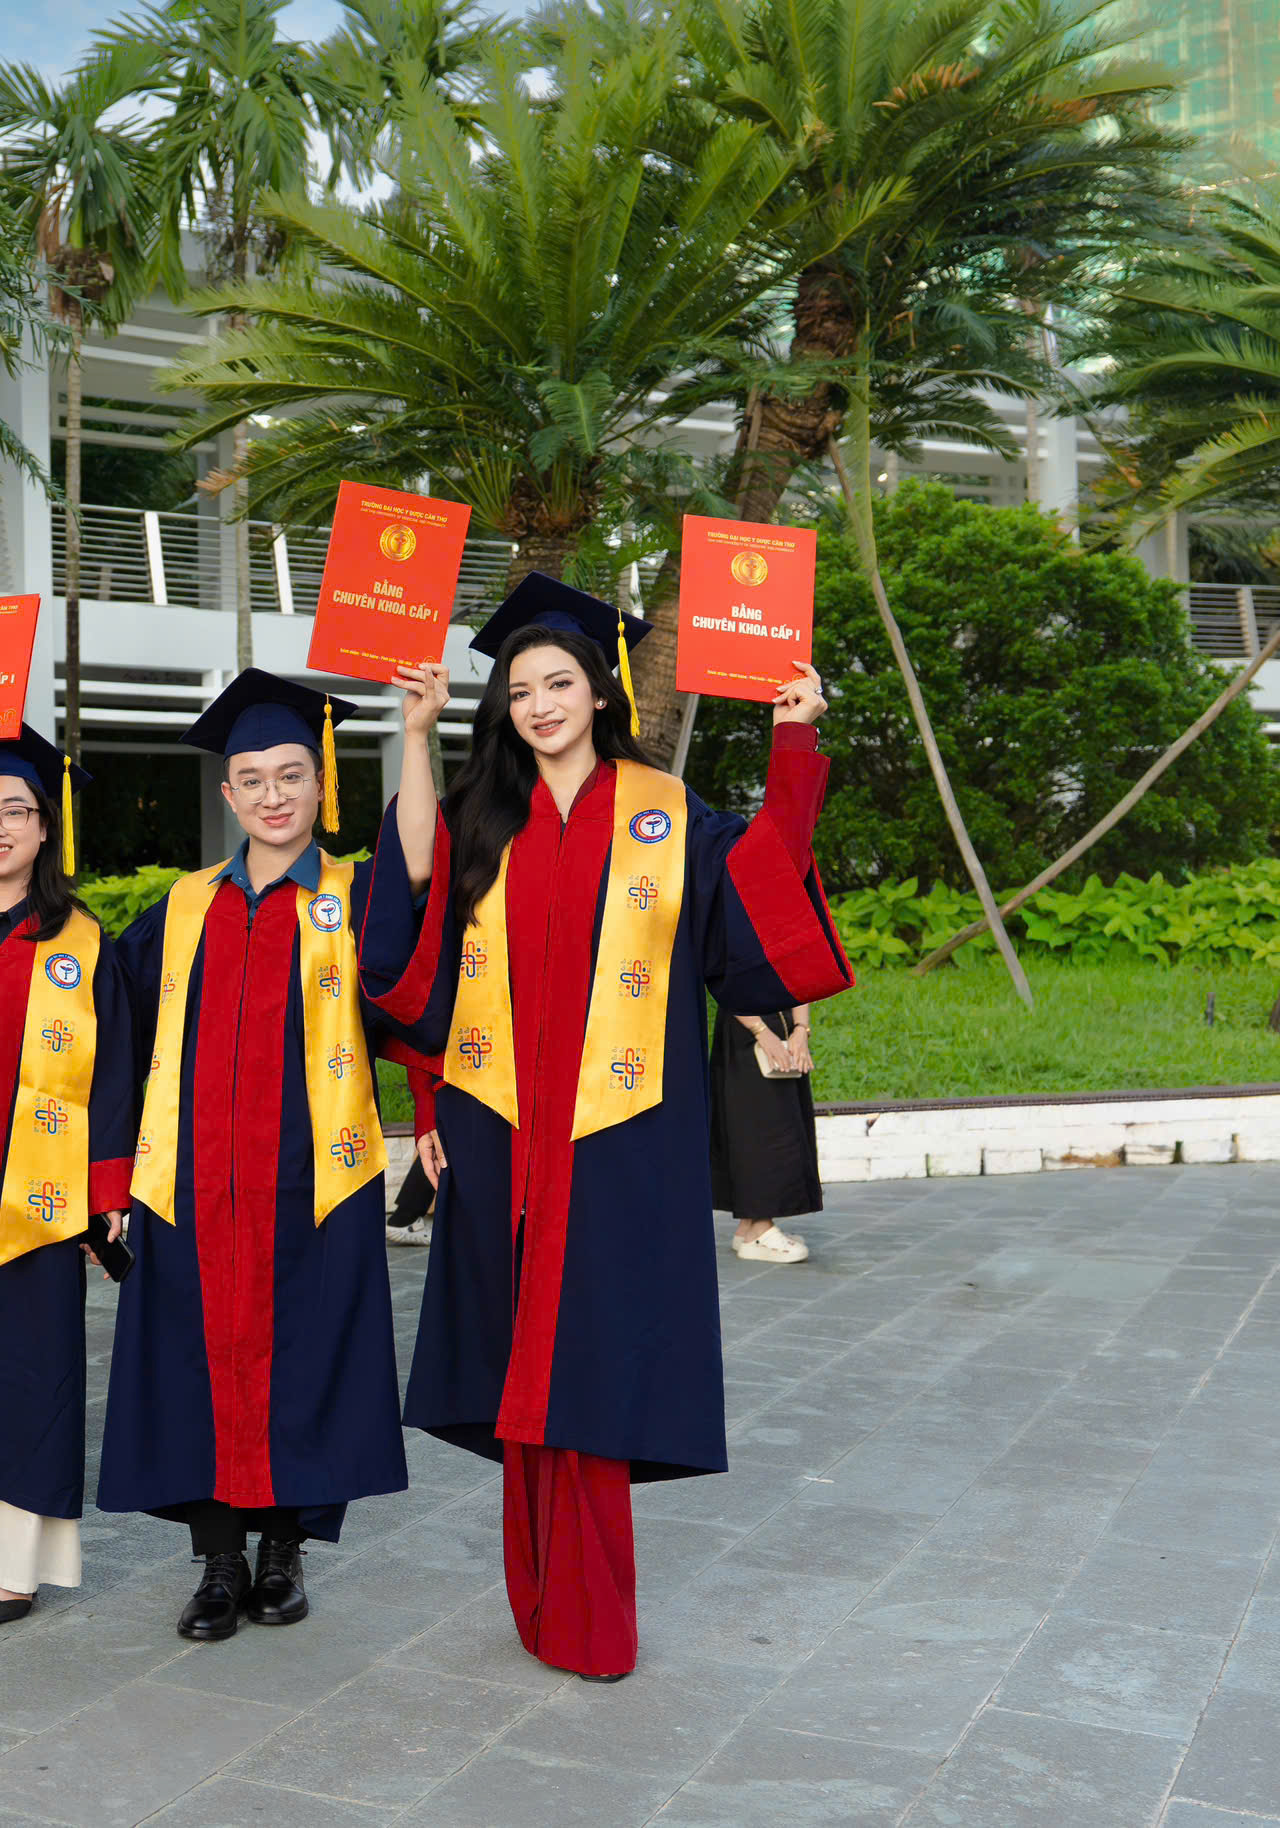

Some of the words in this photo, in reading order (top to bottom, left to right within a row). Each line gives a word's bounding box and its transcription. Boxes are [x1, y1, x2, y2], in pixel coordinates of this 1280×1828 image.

[373, 579, 403, 599] BẰNG
[333, 590, 376, 610] CHUYÊN
[377, 599, 406, 616] KHOA
[409, 603, 431, 620] CẤP
[433, 610, 438, 622] I
[731, 603, 762, 621] BẰNG
[692, 615, 736, 632] CHUYÊN
[739, 622, 768, 637] KHOA
[771, 624, 793, 640] CẤP
[795, 630, 801, 641] I
[11, 674, 15, 683] I
